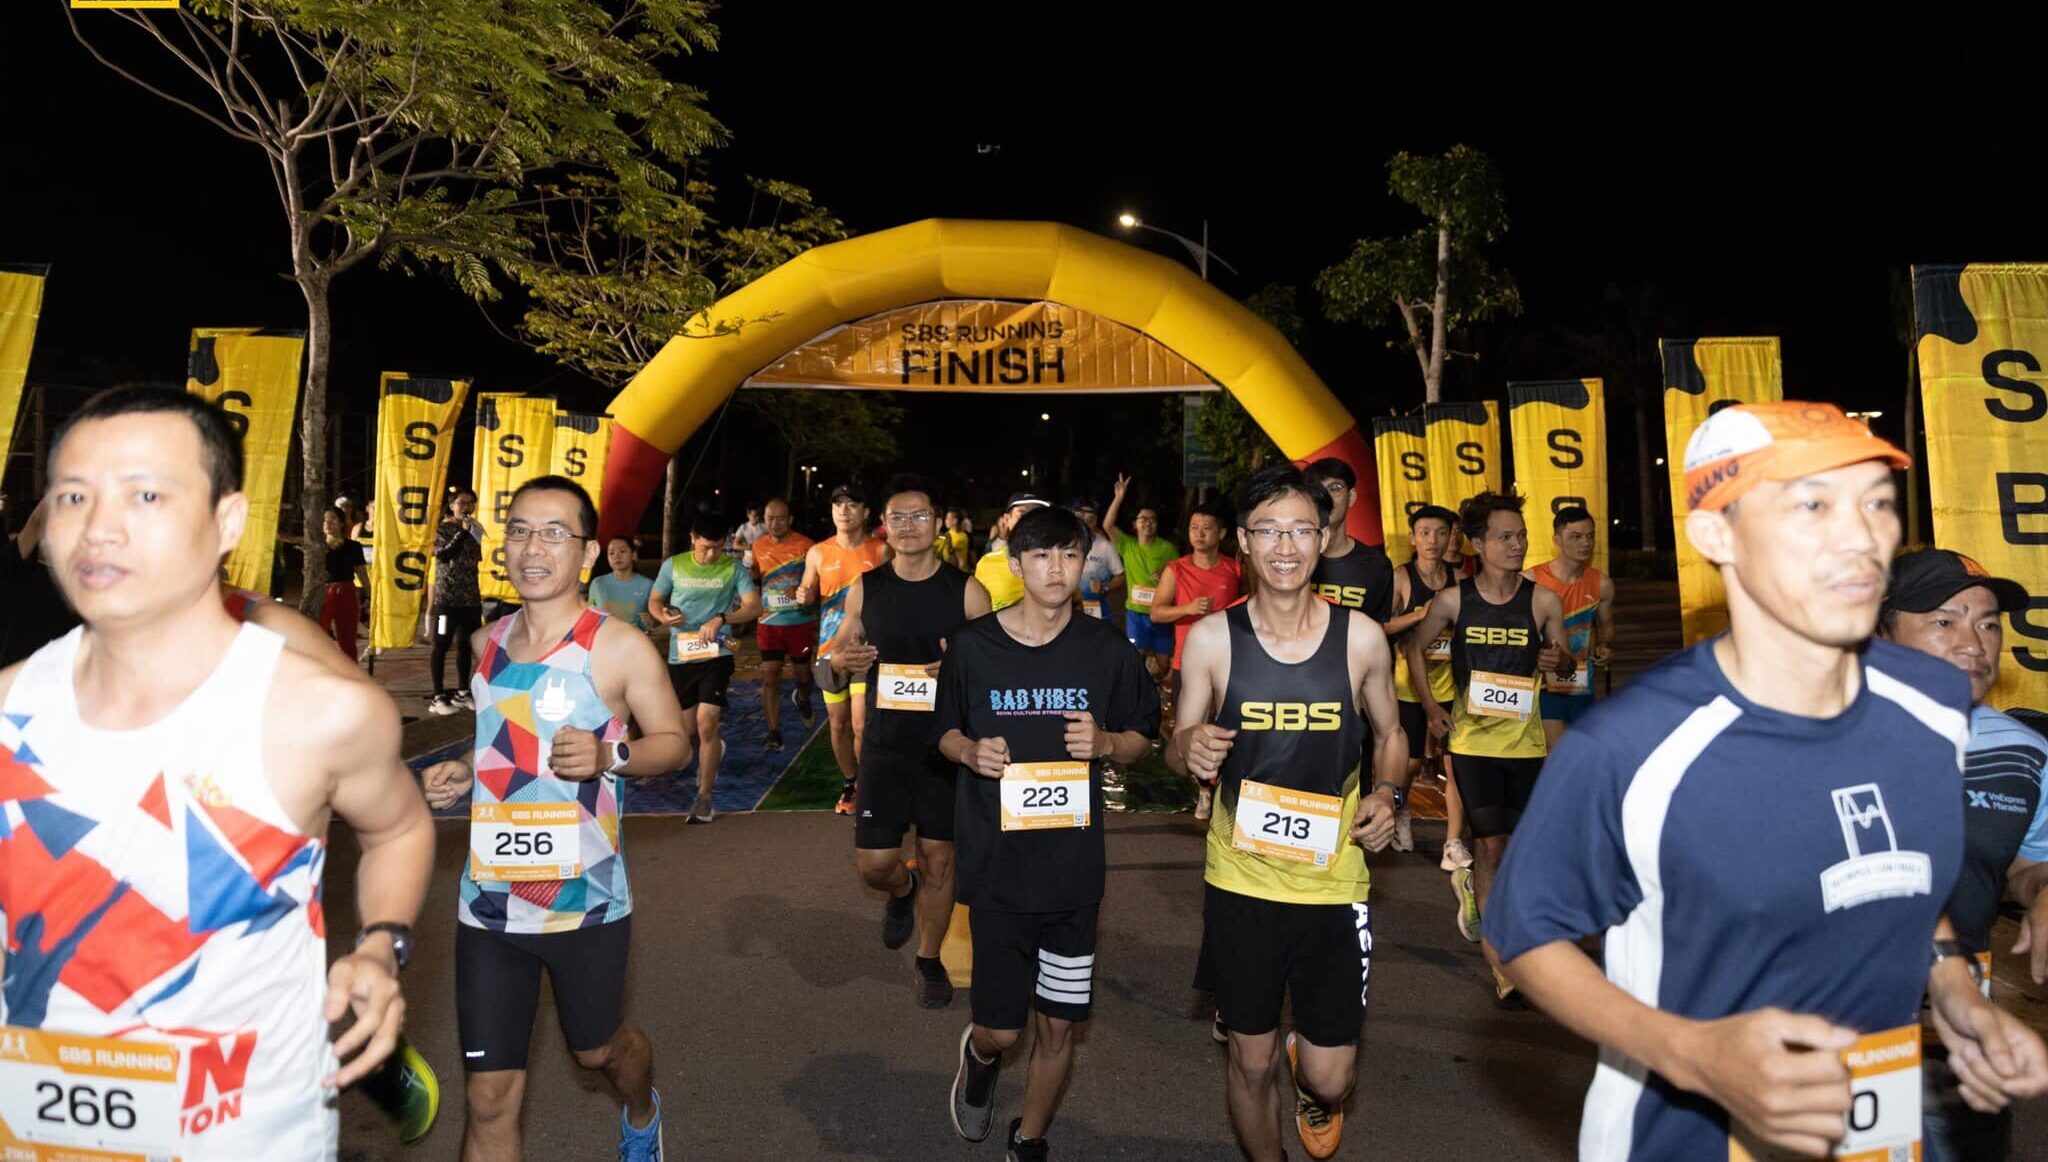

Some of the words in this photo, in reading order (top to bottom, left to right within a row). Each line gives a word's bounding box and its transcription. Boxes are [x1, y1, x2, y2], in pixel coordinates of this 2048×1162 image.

[902, 323, 950, 343] SBS
[956, 320, 1063, 344] RUNNING
[901, 347, 1066, 385] FINISH
[1465, 626, 1529, 647] SBS
[893, 680, 929, 697] 244
[989, 689, 1030, 711] BAD
[1031, 687, 1090, 710] VIBES
[1483, 688, 1519, 706] 204
[1240, 701, 1343, 732] SBS
[1021, 785, 1070, 809] 223
[1988, 791, 2027, 805] VnExpress
[1992, 801, 2029, 814] Marathon
[532, 809, 577, 820] RUNNING
[1262, 811, 1311, 840] 213
[495, 831, 554, 857] 256
[58, 1045, 92, 1066] SBS
[95, 1048, 173, 1073] RUNNING
[1847, 1040, 1919, 1068] RUNNING
[35, 1080, 137, 1131] 266
